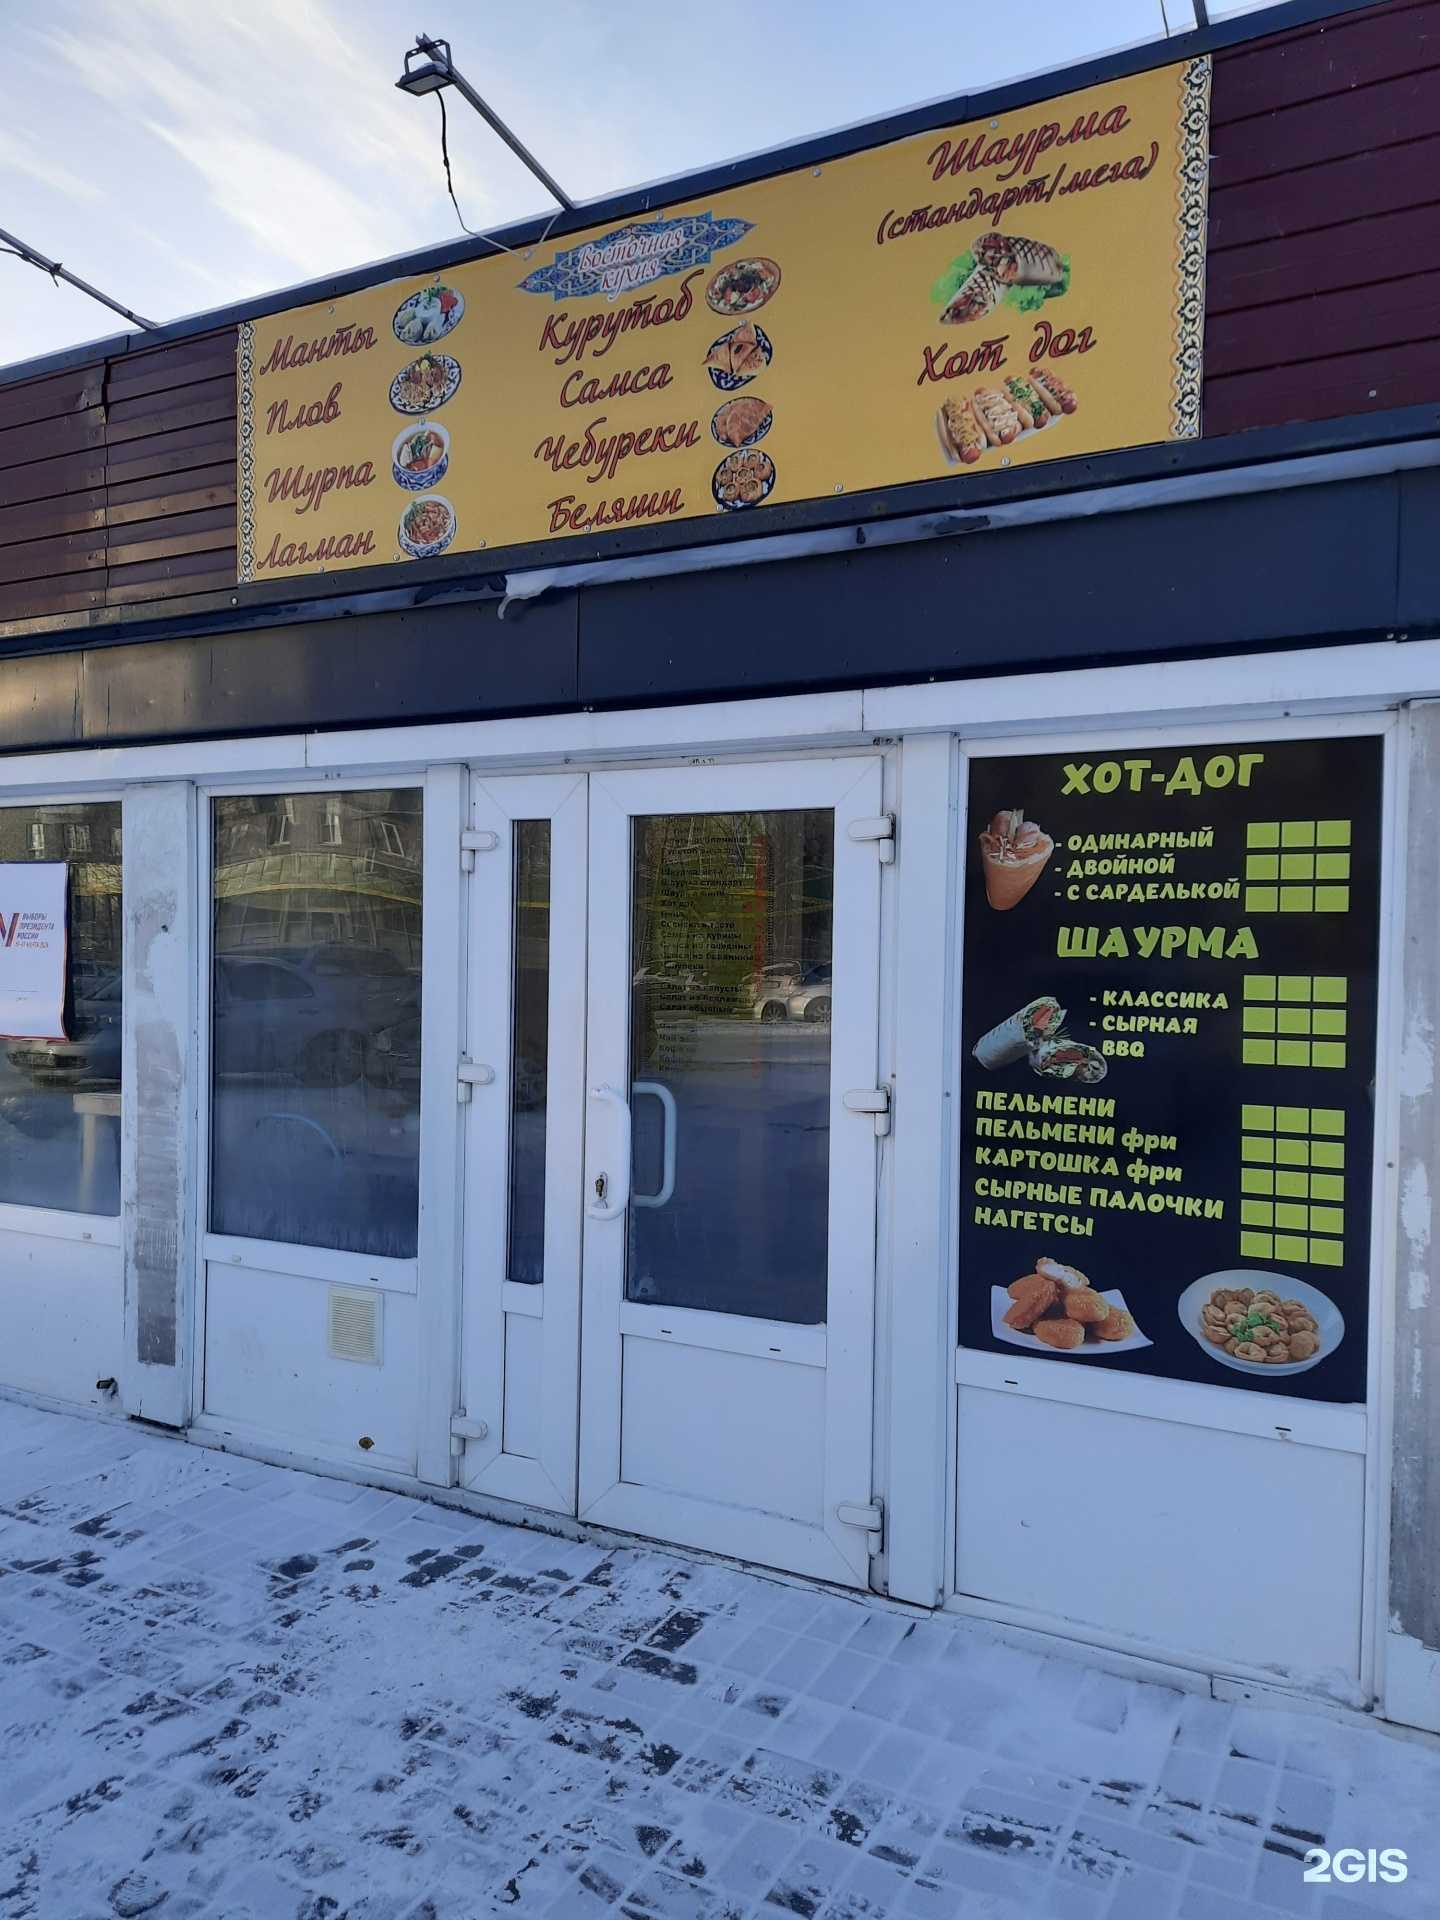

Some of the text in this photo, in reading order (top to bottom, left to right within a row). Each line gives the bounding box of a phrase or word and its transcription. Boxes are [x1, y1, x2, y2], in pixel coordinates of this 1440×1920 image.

[927, 105, 1132, 182] Шаурма
[876, 141, 1160, 245] (стандарт/мега)
[579, 227, 684, 271] Восточная
[539, 269, 704, 365] Курутоб
[260, 323, 378, 375] Манты
[917, 320, 1097, 385] Хот дог
[560, 363, 673, 408] Самса
[266, 382, 342, 434] Плов
[534, 417, 701, 483] Чебуреки
[264, 461, 376, 514] Шурпа
[547, 488, 685, 532] Беляши
[257, 530, 376, 569] Лагман
[1060, 753, 1265, 796] ХОТ-ДОГ
[1067, 826, 1214, 855] ОДИНАРНЫЙ
[1066, 853, 1176, 879] ДВОЙНОЙ
[1086, 878, 1240, 903] САРДЕЛЬКОЙ
[1056, 926, 1260, 960] ШАУРМА
[1102, 990, 1229, 1010] КЛАССИКА
[1102, 1015, 1198, 1034] СЫРНАЯ
[1102, 1040, 1145, 1058] BBQ
[975, 1091, 1116, 1118] ПЕЛЬМЕНИ
[975, 1118, 1177, 1154] ПЕЛЬМЕНИ фри
[975, 1147, 1183, 1186] КАРТОШКА фри
[974, 1178, 1225, 1220] СЫРНЫЕ ПАЛОЧКИ
[974, 1206, 1095, 1237] НАГЕТСЫ
